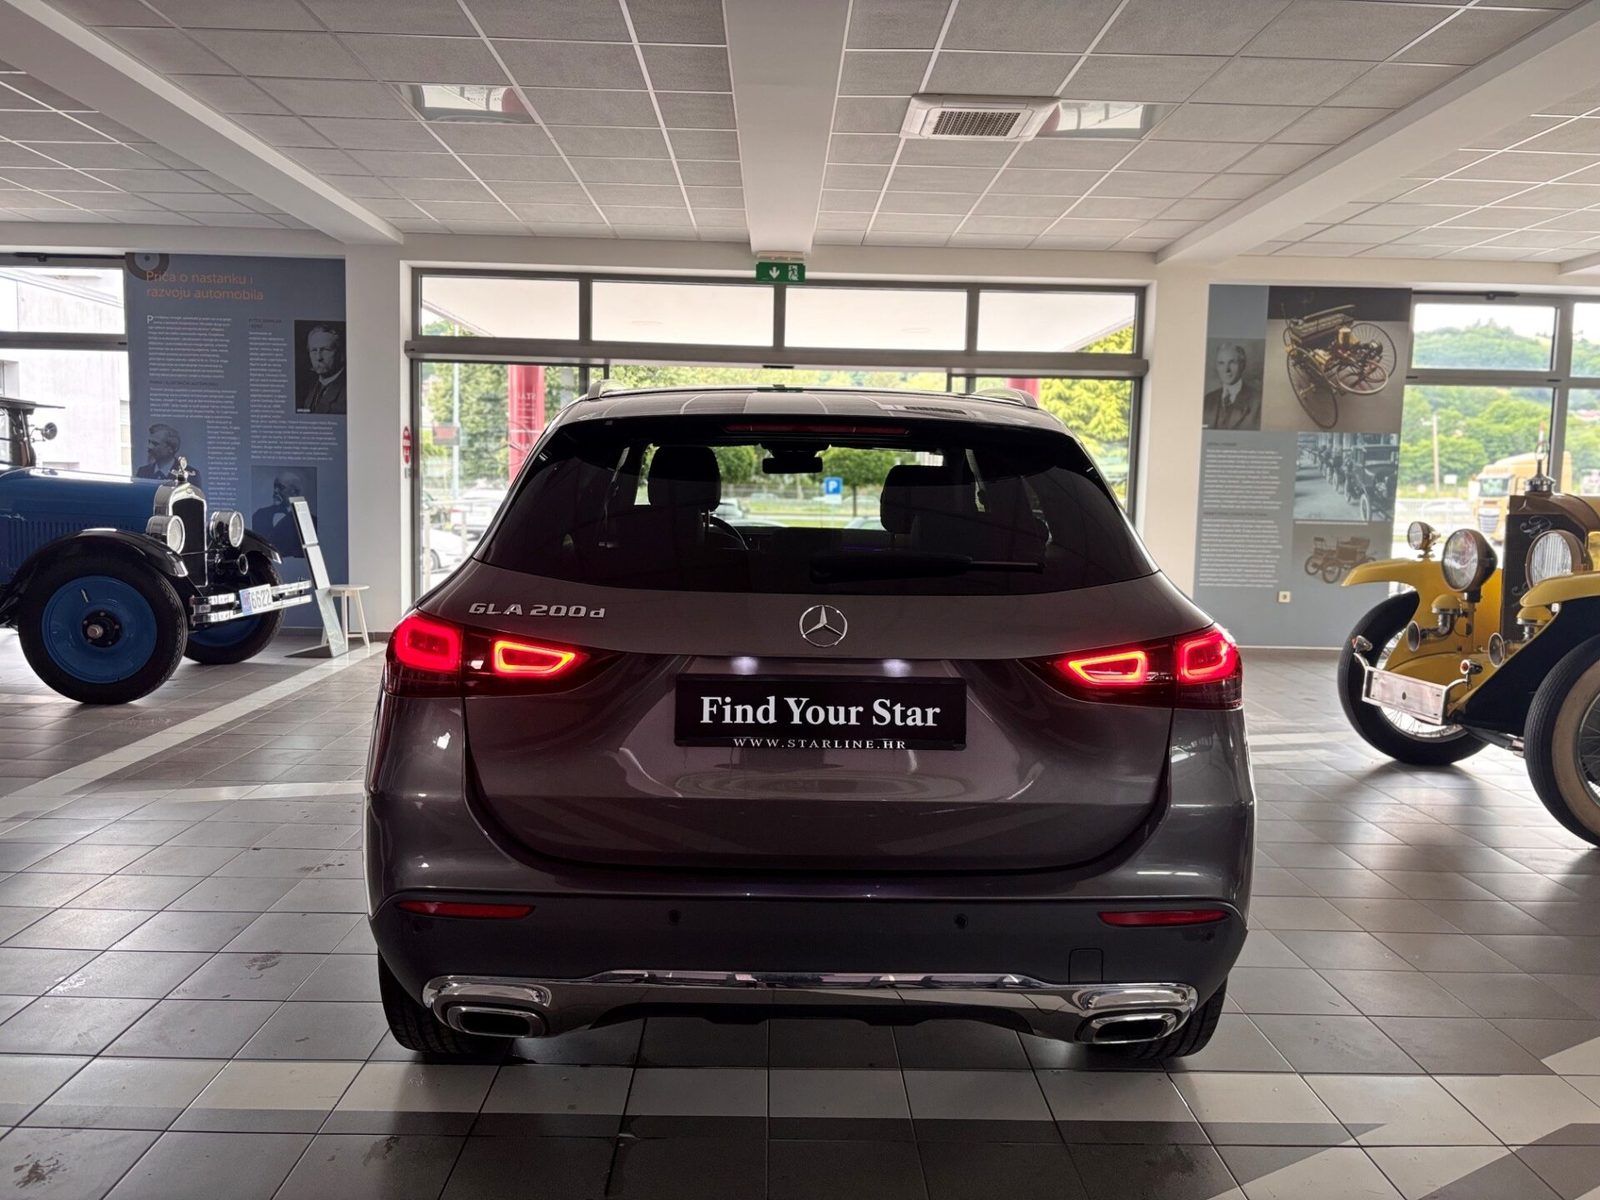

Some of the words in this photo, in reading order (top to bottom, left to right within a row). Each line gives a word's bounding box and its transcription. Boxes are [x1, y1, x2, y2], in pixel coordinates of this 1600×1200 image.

[191, 272, 247, 285] nastanku
[146, 287, 191, 300] razvoju
[194, 289, 264, 301] automobila
[828, 480, 838, 492] P
[468, 602, 523, 616] GLA
[529, 604, 606, 619] 200d
[700, 695, 777, 725] Find
[784, 697, 864, 727] Your
[872, 698, 941, 727] Star
[733, 737, 906, 750] WWW.STARLINE.HR
